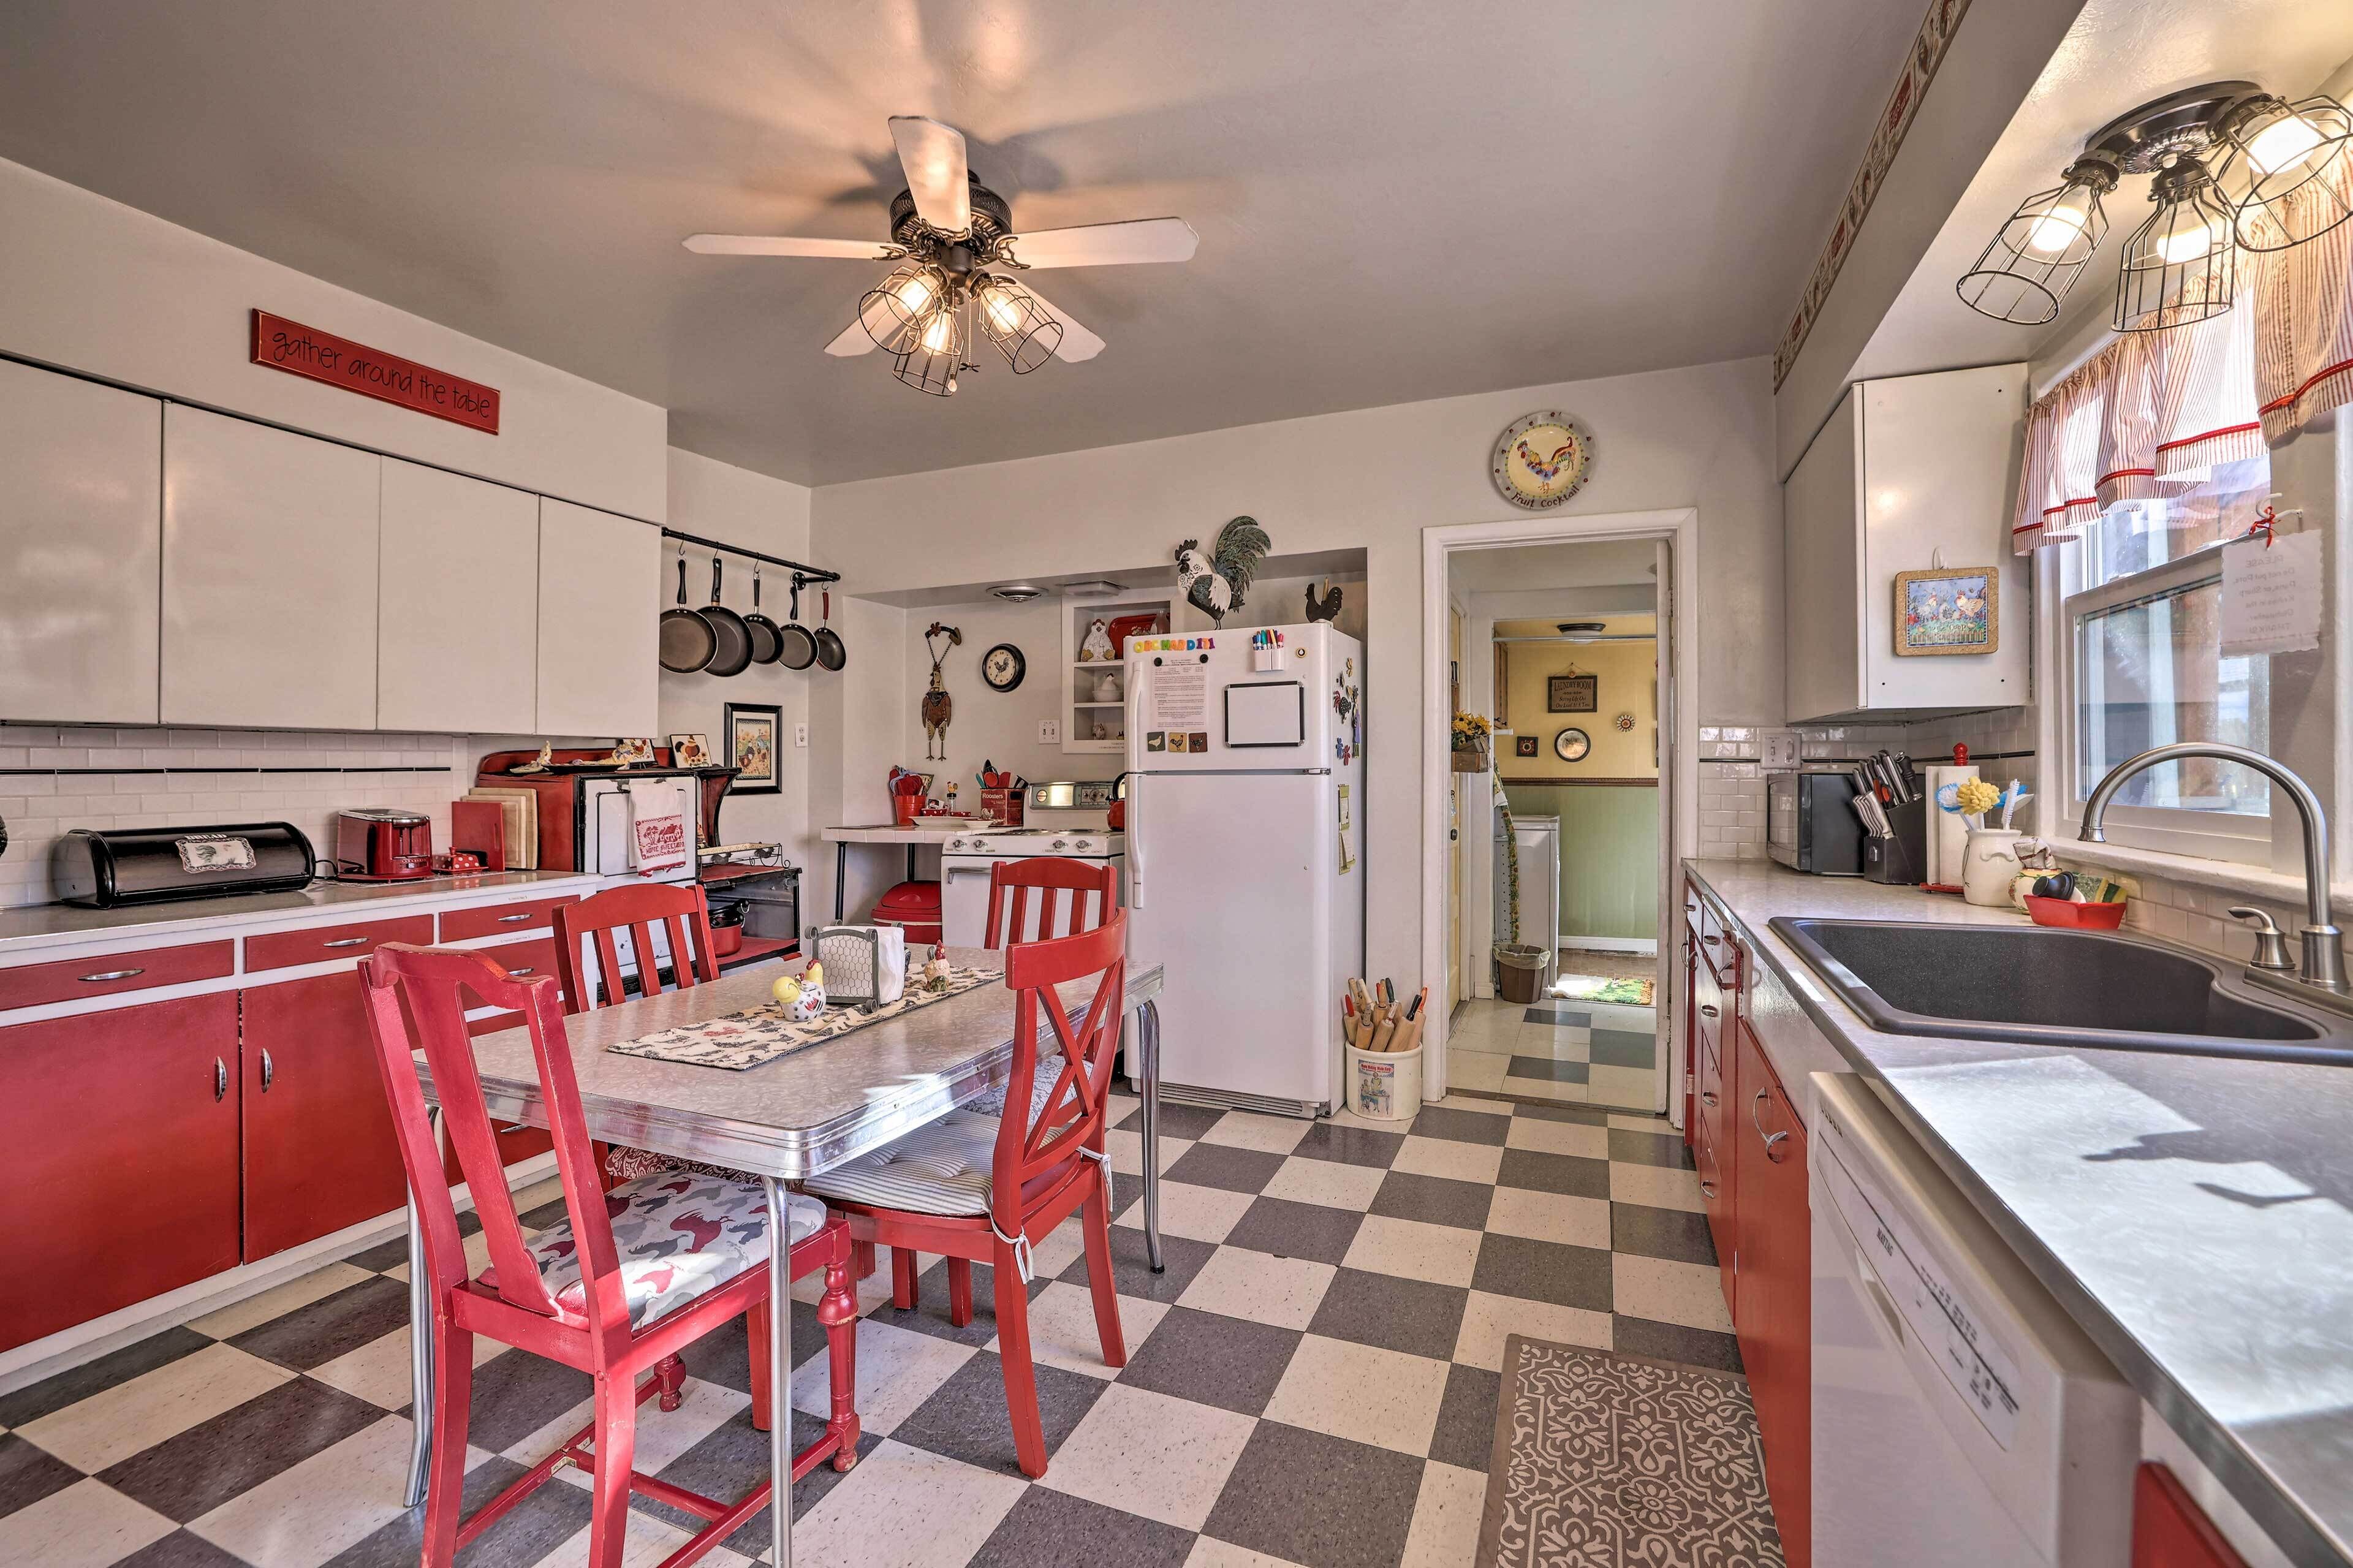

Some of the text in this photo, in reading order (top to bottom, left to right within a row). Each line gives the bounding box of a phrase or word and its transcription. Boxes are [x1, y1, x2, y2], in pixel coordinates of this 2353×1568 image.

[272, 331, 491, 418] gather around the table
[1511, 485, 1580, 509] Fruit Cocktail
[1554, 681, 1591, 691] LAUNDRY ROOM
[646, 846, 659, 854] HOME
[661, 843, 675, 851] SWEET
[1876, 1227, 1893, 1257] MAYTAG
